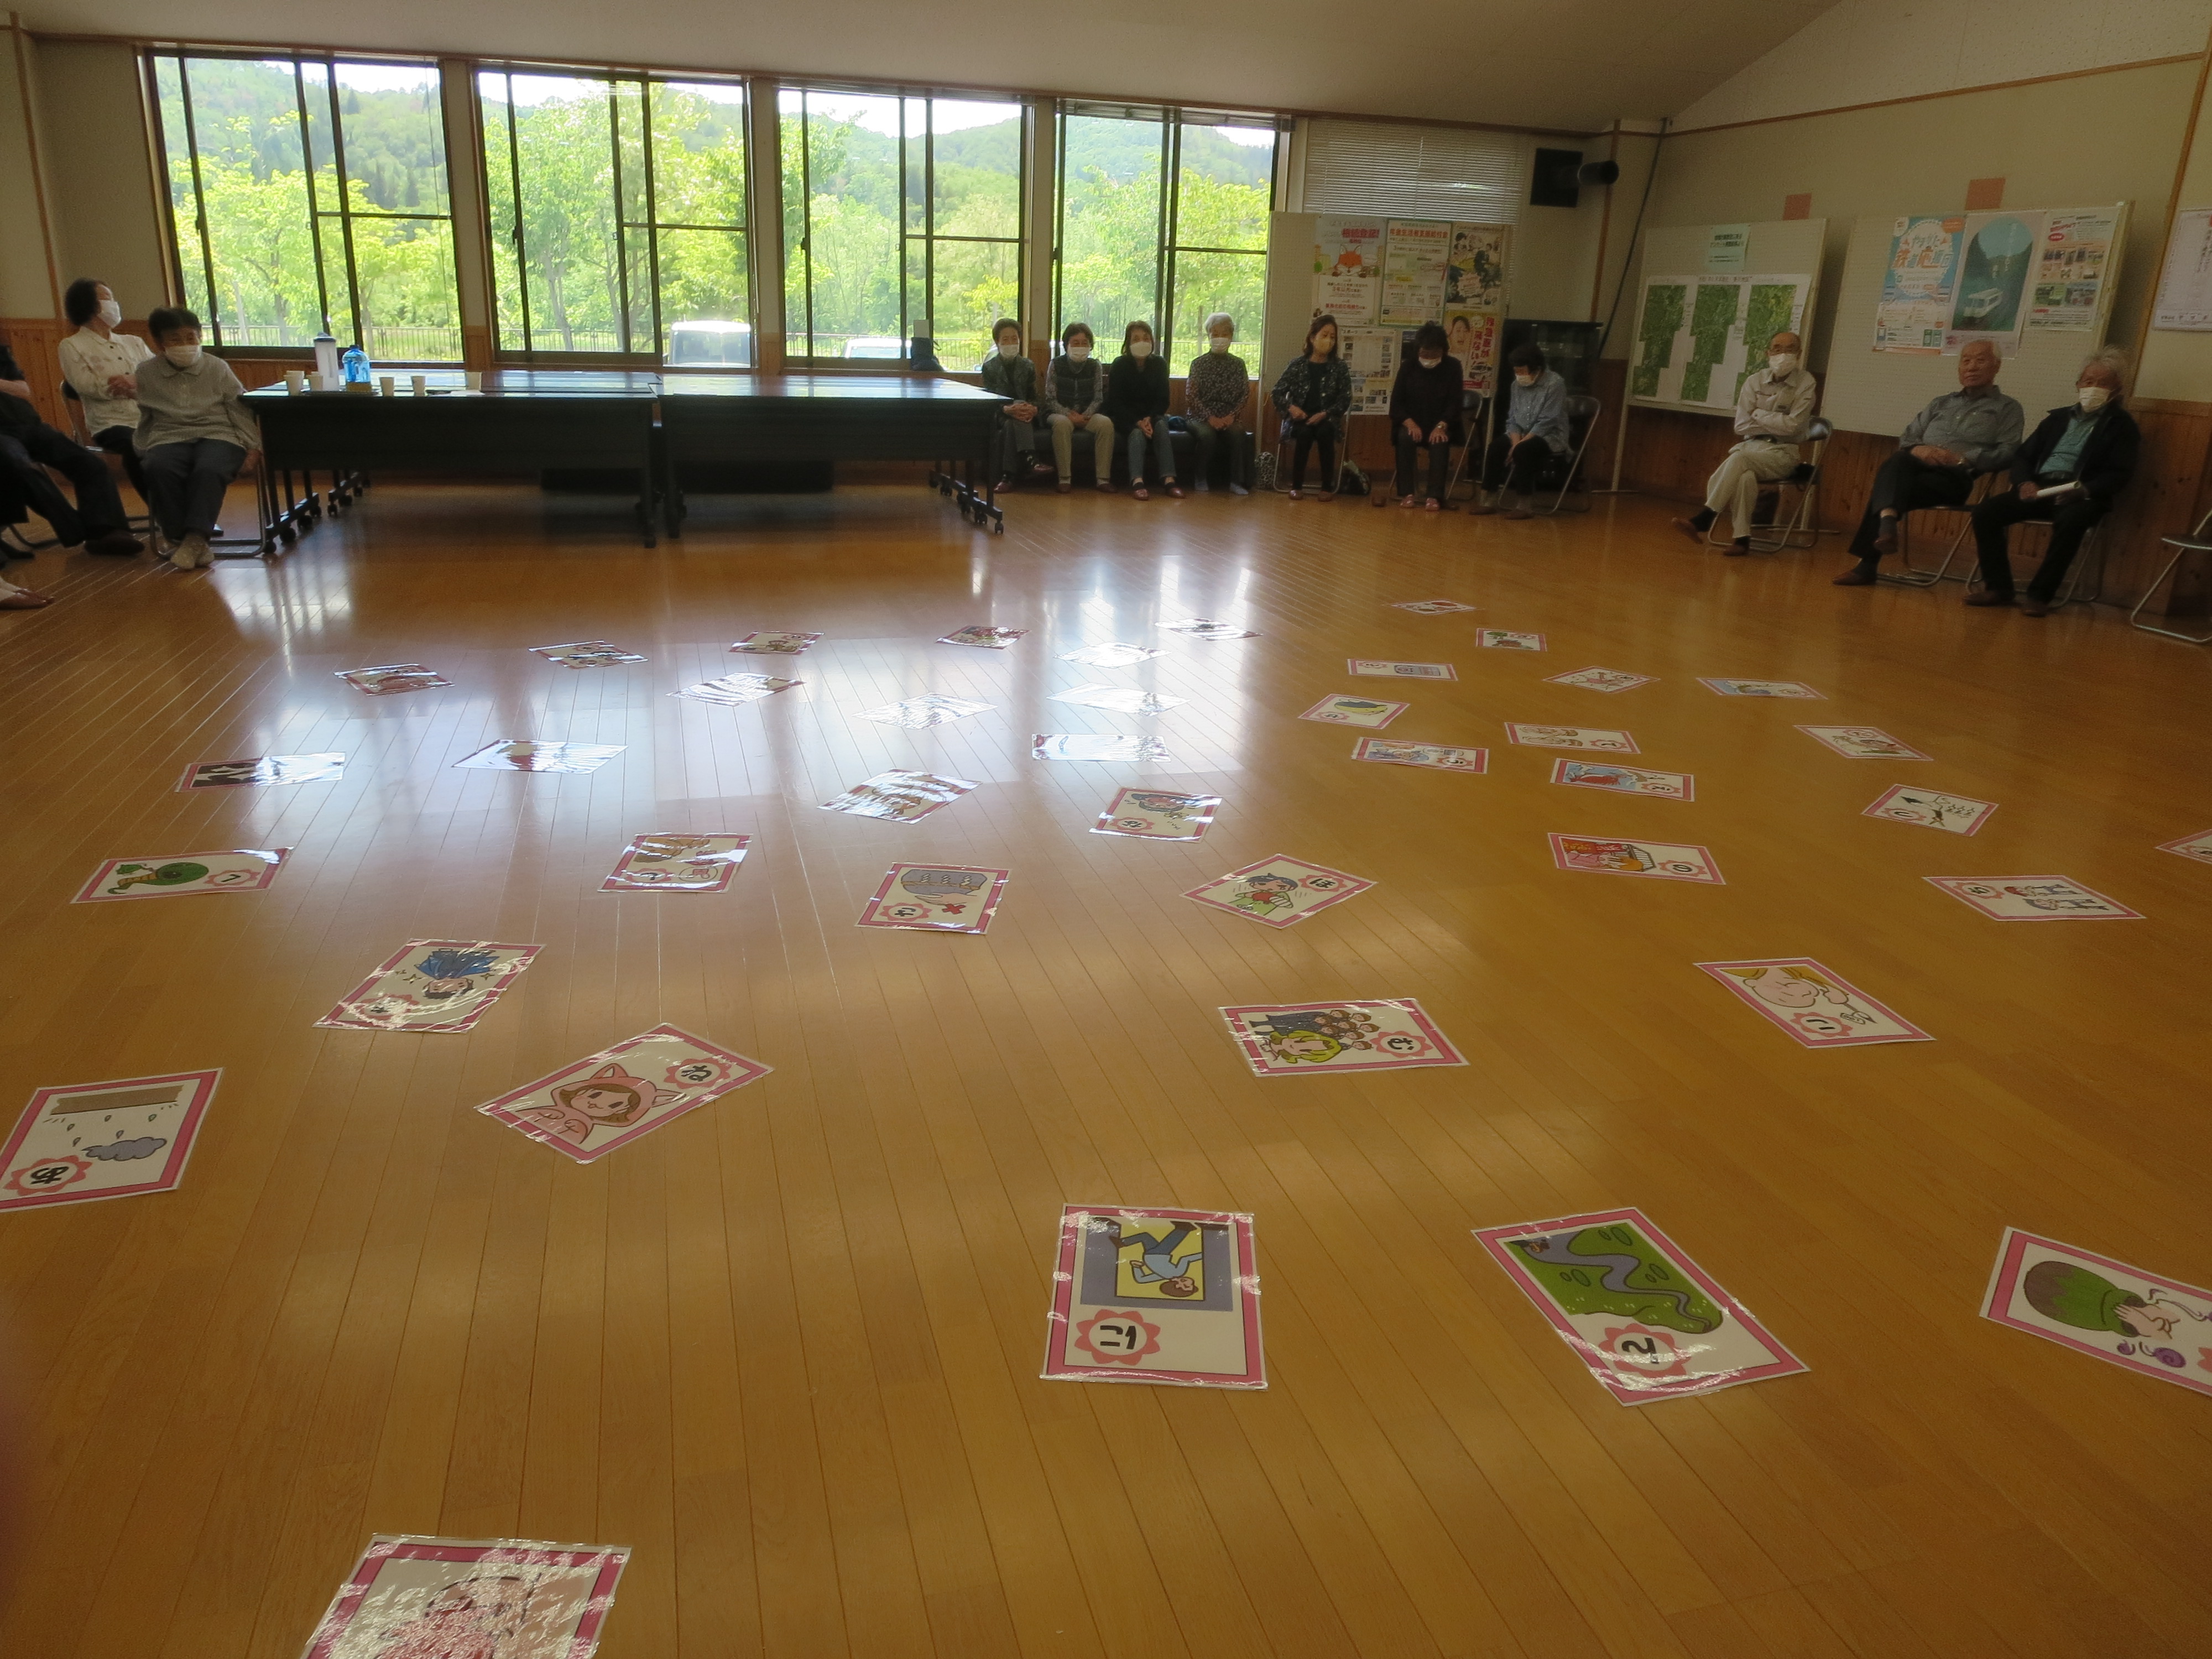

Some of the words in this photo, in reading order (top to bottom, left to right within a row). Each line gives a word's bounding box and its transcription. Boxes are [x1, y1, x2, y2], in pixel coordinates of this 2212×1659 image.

[221, 874, 241, 883] へ
[1309, 878, 1335, 889] ほ
[894, 907, 916, 917] さ
[1806, 1019, 1835, 1030] こ
[1387, 1037, 1414, 1050] む
[681, 1065, 712, 1082] ね
[30, 1166, 70, 1185] あ
[1099, 1325, 1137, 1350] に
